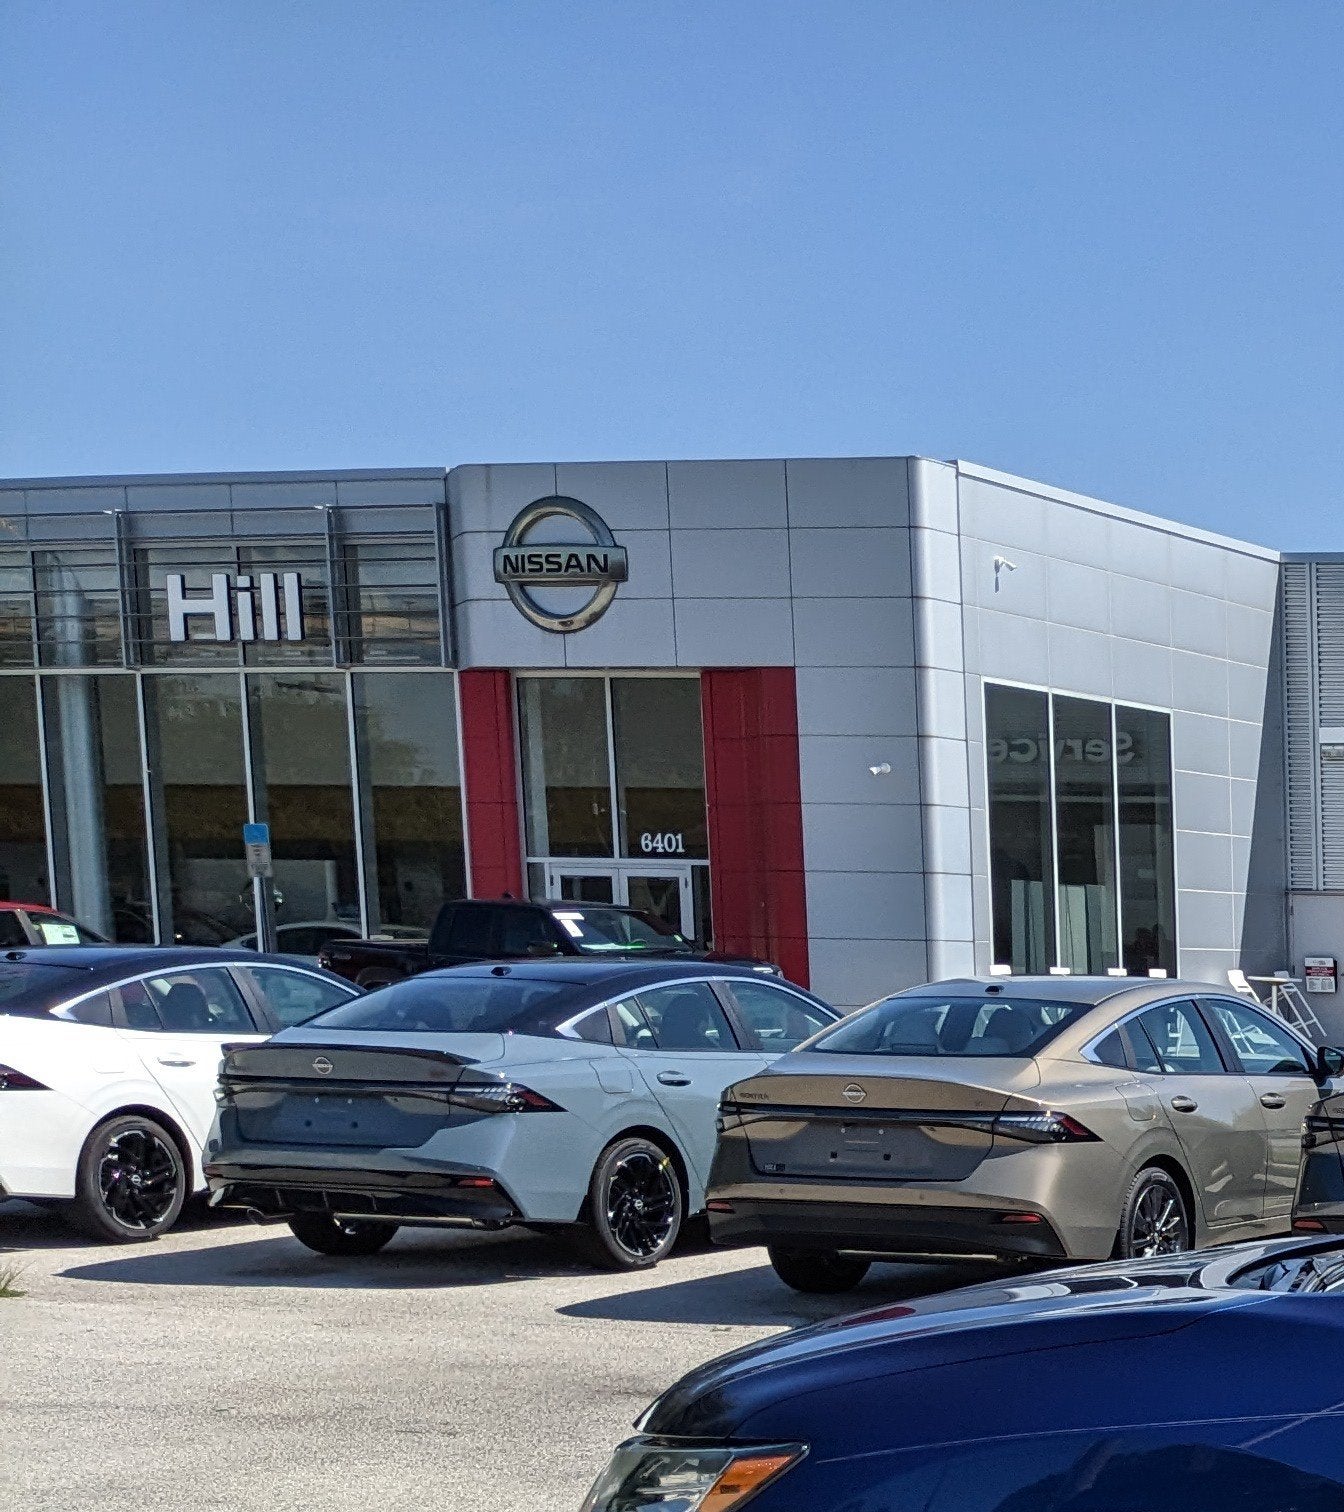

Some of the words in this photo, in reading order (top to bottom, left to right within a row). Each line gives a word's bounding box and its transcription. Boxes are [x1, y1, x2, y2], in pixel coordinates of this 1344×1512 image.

[502, 553, 609, 574] NISSAN
[166, 572, 304, 642] Hill
[640, 832, 686, 853] 6401
